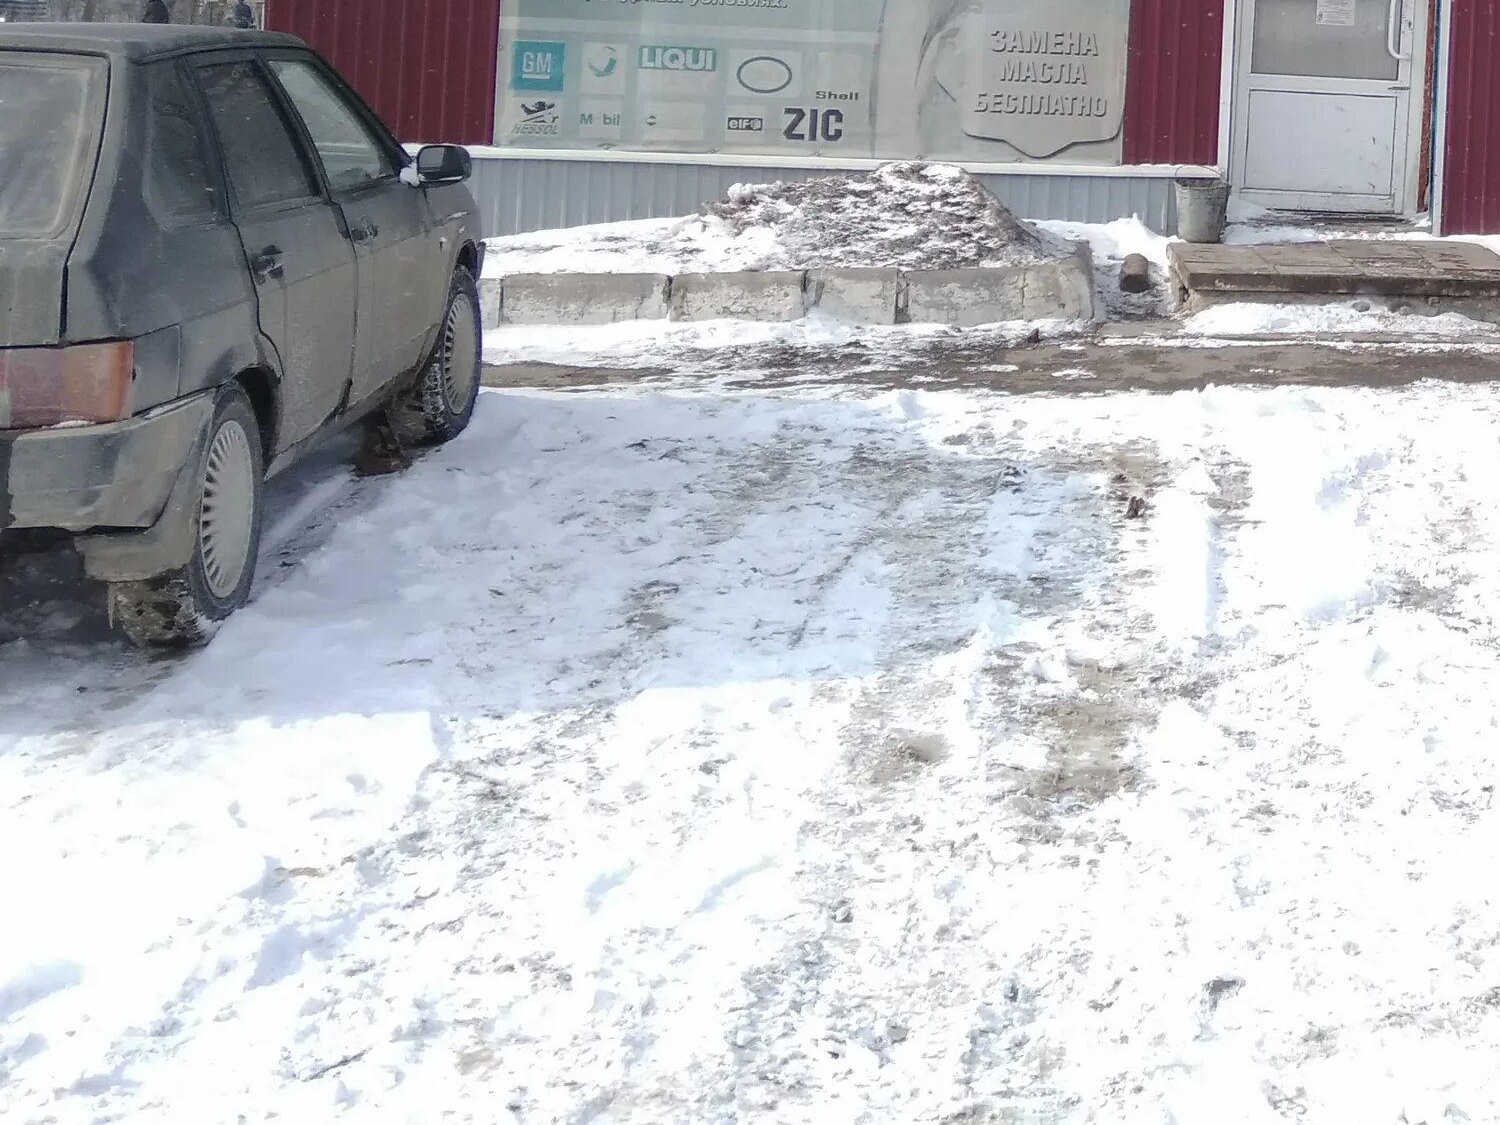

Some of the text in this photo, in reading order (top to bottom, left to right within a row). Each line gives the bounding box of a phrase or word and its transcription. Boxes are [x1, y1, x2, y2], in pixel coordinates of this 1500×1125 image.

[991, 29, 1099, 56] ЗАМЕНА
[522, 51, 552, 73] GM
[642, 47, 713, 70] LIQUI
[1000, 60, 1087, 85] МАСЛА
[816, 91, 859, 101] Shell
[974, 91, 1107, 117] БЕСПЛАТНО
[510, 122, 559, 135] HESSOL
[580, 113, 621, 126] Mbil
[783, 107, 844, 142] ZIC
